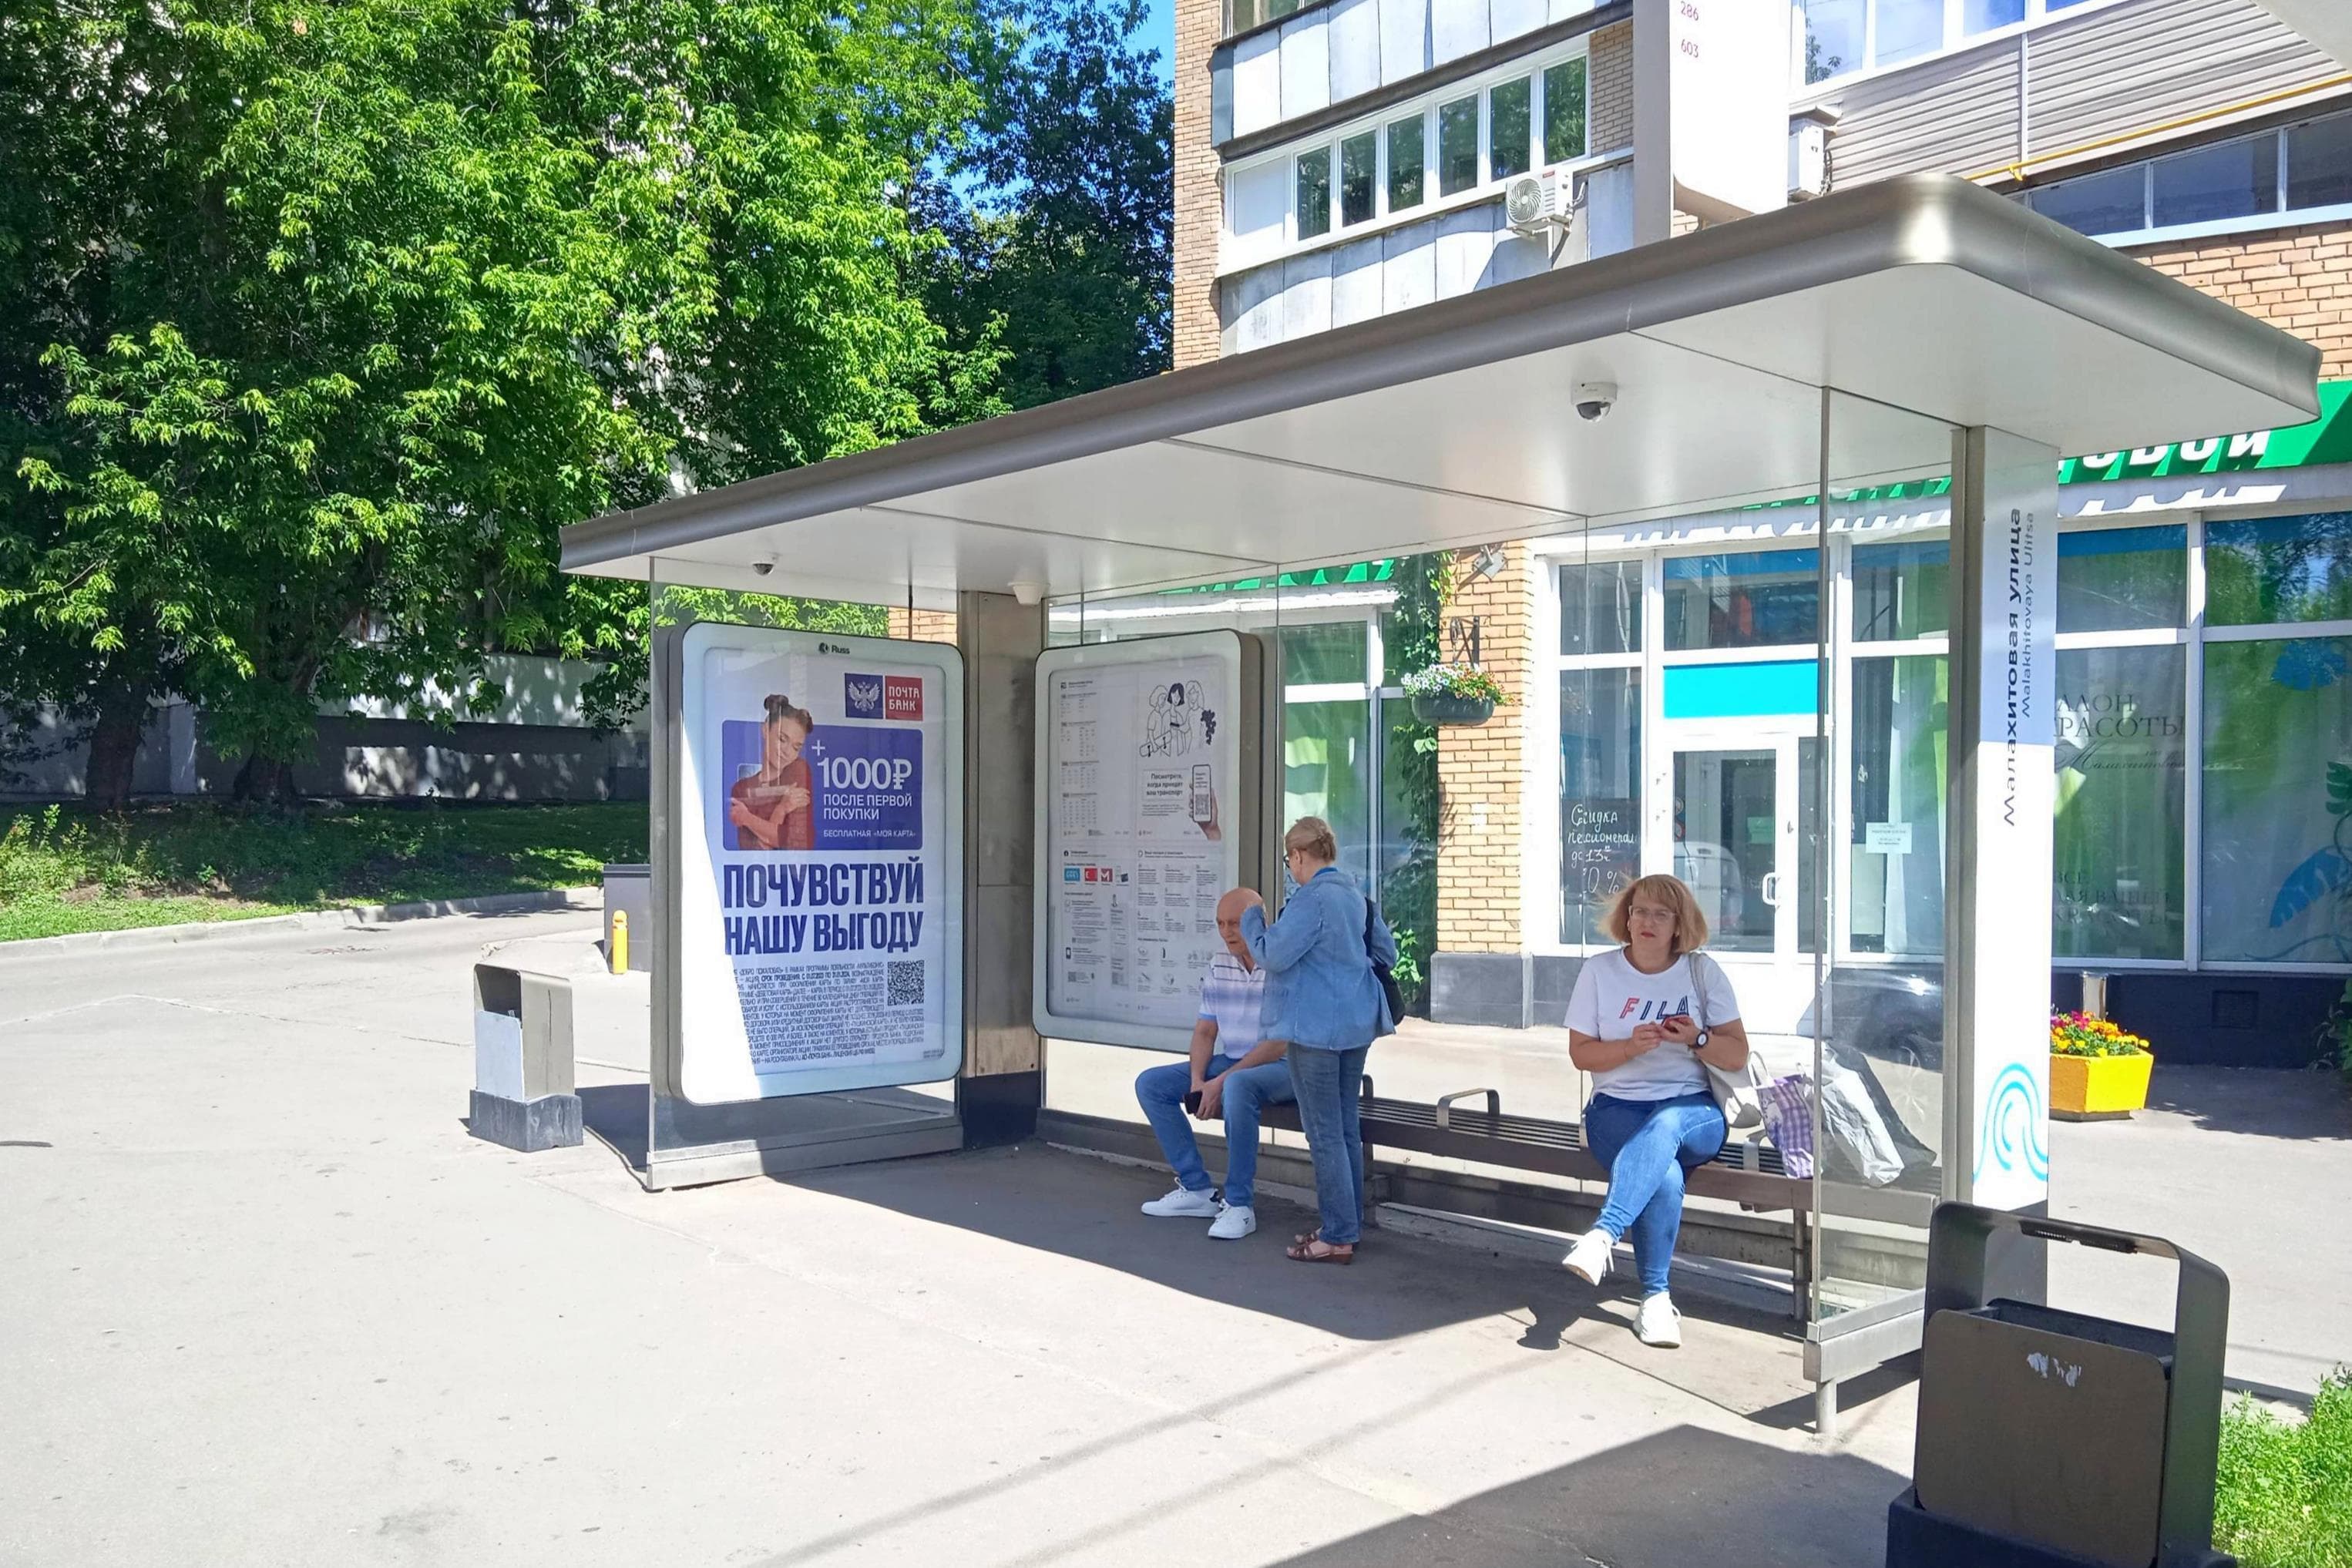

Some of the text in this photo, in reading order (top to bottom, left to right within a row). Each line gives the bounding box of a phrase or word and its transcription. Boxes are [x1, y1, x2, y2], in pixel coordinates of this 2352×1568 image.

[1680, 1, 1699, 21] 286
[1681, 39, 1699, 58] 603
[2021, 511, 2034, 718] Malakhitovaya Ulitsa
[831, 645, 851, 655] Russ
[2003, 508, 2022, 827] Малахитовая улица
[888, 685, 920, 700] ПОЧТА
[889, 699, 916, 712] БАНК
[2058, 693, 2135, 713] АЛОН
[2055, 717, 2184, 737] РАСОТЫ
[823, 794, 912, 808] ПОСЛЕ ПЕРВОЙ
[823, 808, 880, 821] ПОКУПКИ
[823, 829, 872, 838] БЕСПЛАТНАЯ
[723, 856, 924, 908] ПОЧУВСТВУЙ
[724, 911, 924, 955] НАШУ ВЫГОДУ
[1619, 996, 1689, 1020] FILA
